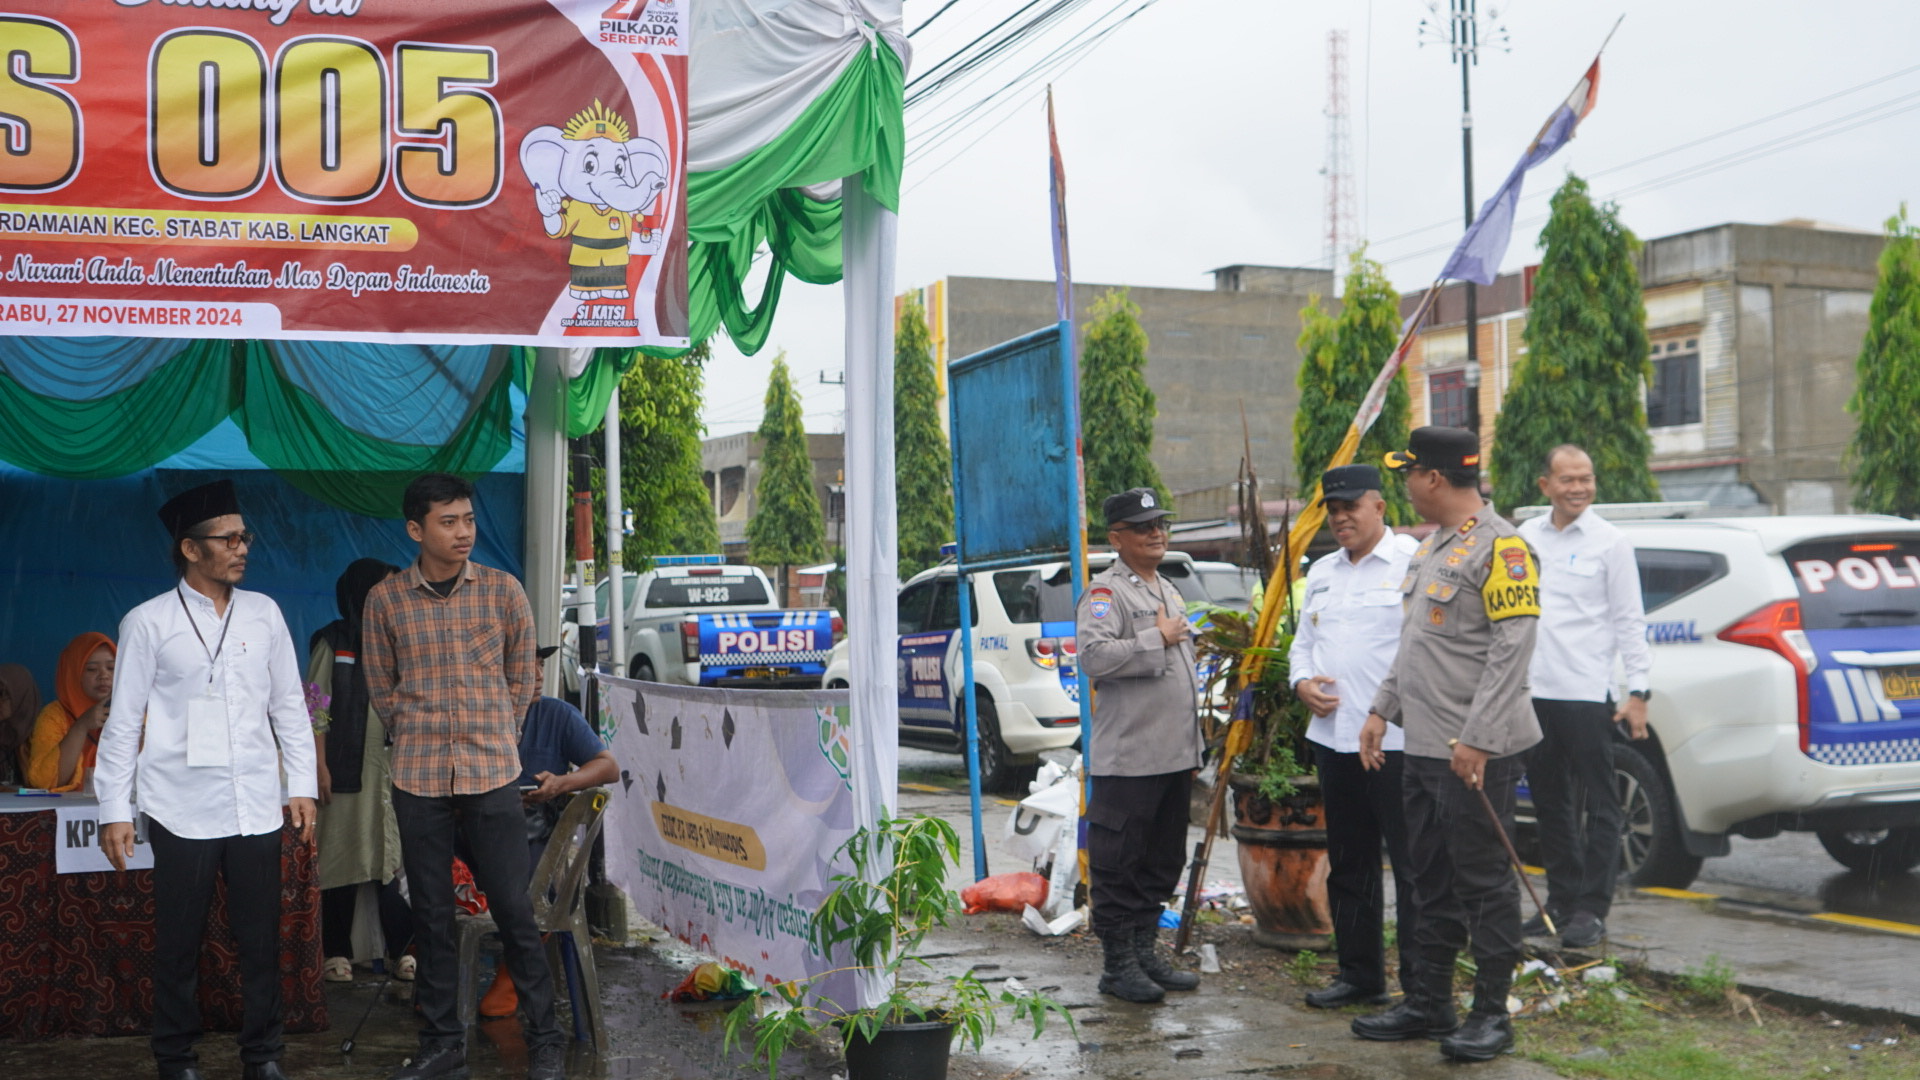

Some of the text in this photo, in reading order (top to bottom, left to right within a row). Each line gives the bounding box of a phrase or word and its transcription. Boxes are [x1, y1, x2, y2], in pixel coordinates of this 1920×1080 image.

[647, 14, 679, 24] 2024
[599, 21, 679, 37] PILKADA
[599, 32, 678, 47] SERENTAK
[147, 26, 504, 210] 005
[0, 212, 391, 244] RDAMAIAN KEC. STABAT KAB. LANGKAT
[8, 253, 490, 296] Nurani Anda Menentukan Mas Depan Indonesia
[57, 304, 78, 324] 27
[83, 305, 191, 326] NOVEMBER
[195, 307, 243, 327] 2024
[576, 304, 627, 320] SI KATSI
[575, 319, 603, 327] LANGKAT
[603, 319, 639, 327] DEMOKRASI
[687, 586, 730, 603] W-923
[718, 629, 815, 654] POLISI
